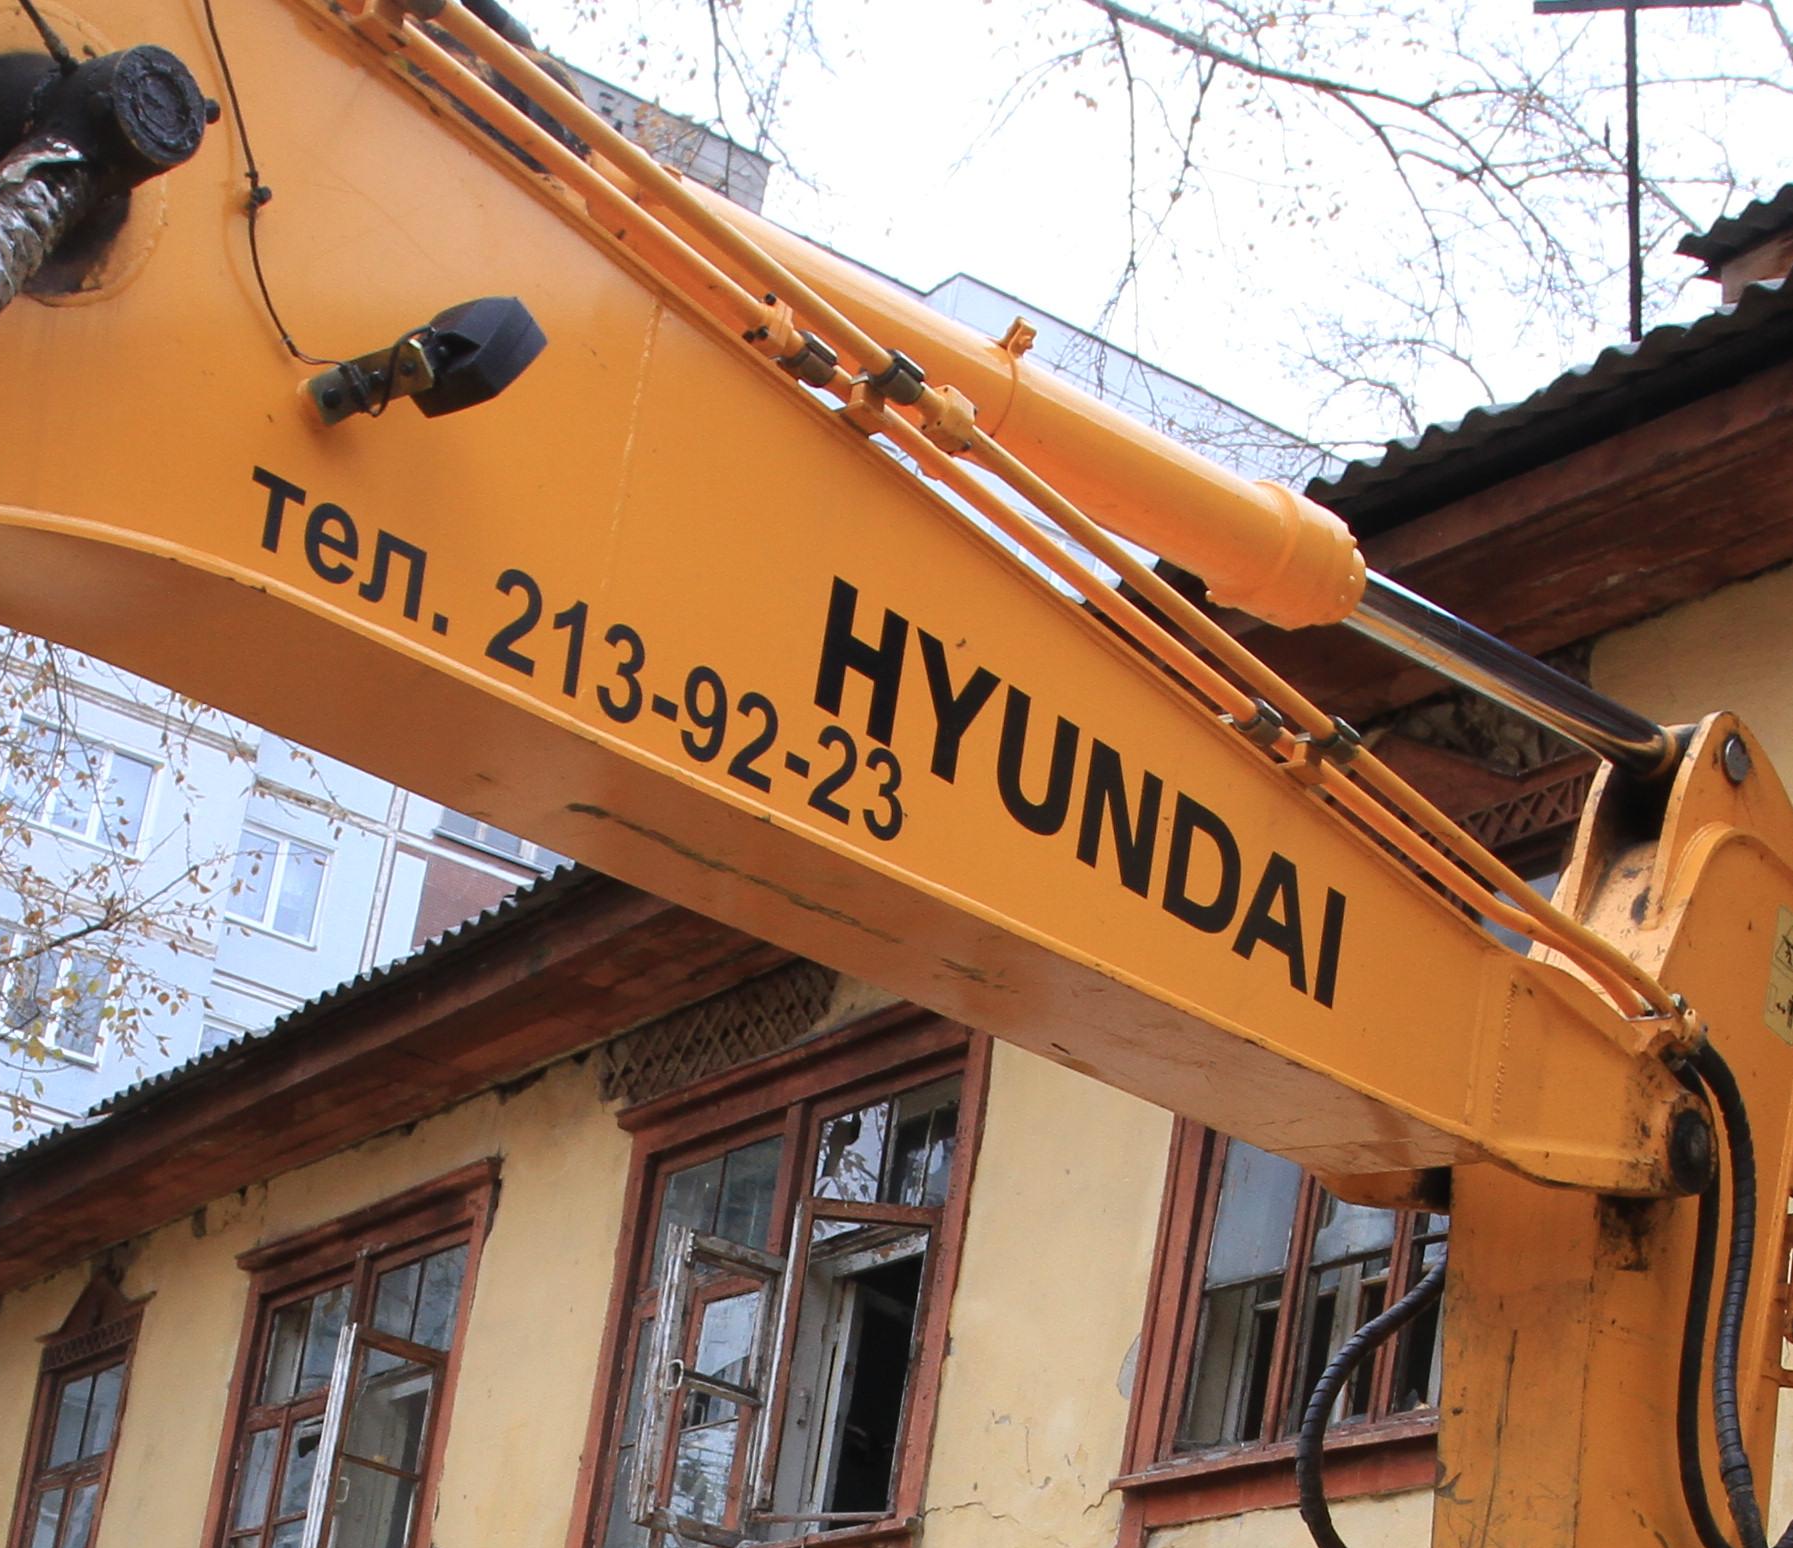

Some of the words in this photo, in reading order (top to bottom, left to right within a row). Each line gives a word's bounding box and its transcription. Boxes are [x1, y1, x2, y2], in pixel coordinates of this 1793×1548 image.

[252, 466, 450, 635] тел.
[484, 568, 907, 842] 213-92-23
[814, 575, 1347, 1010] HYUNDAI
